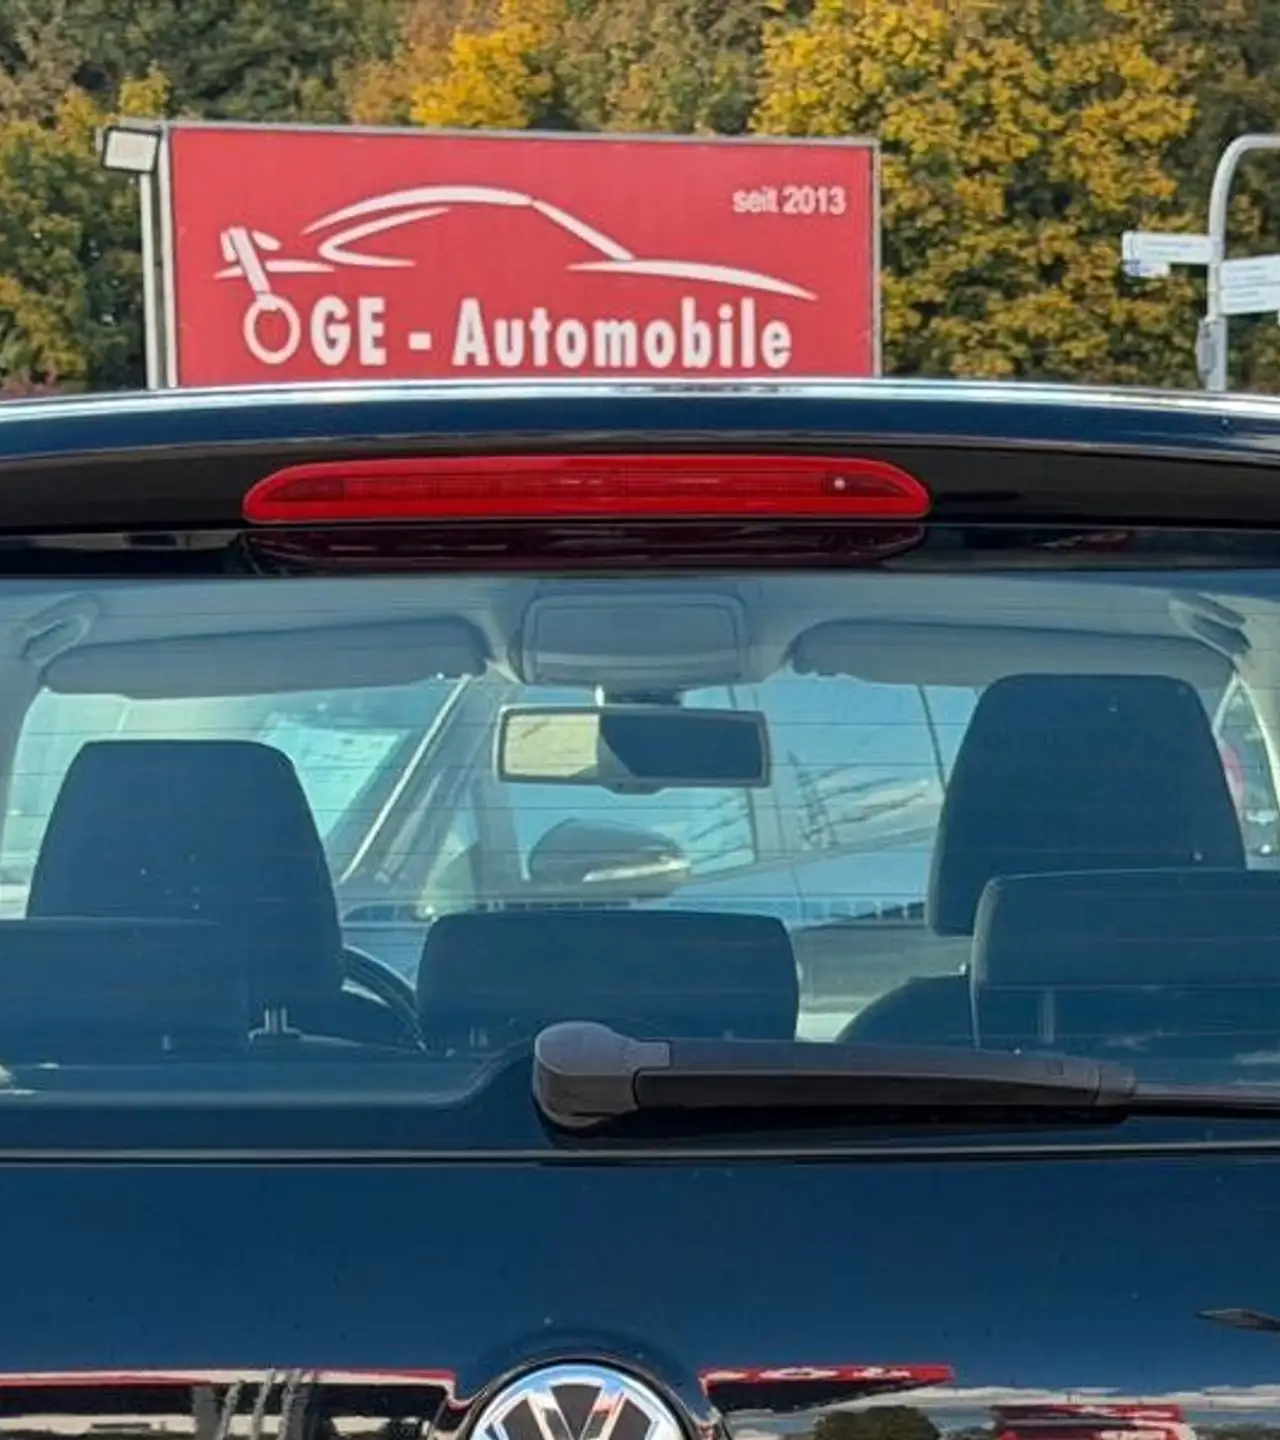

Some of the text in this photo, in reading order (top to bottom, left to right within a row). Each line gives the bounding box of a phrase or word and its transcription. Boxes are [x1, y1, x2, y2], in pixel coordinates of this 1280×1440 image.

[733, 184, 847, 215] seit 2013
[451, 297, 792, 368] Automobile
